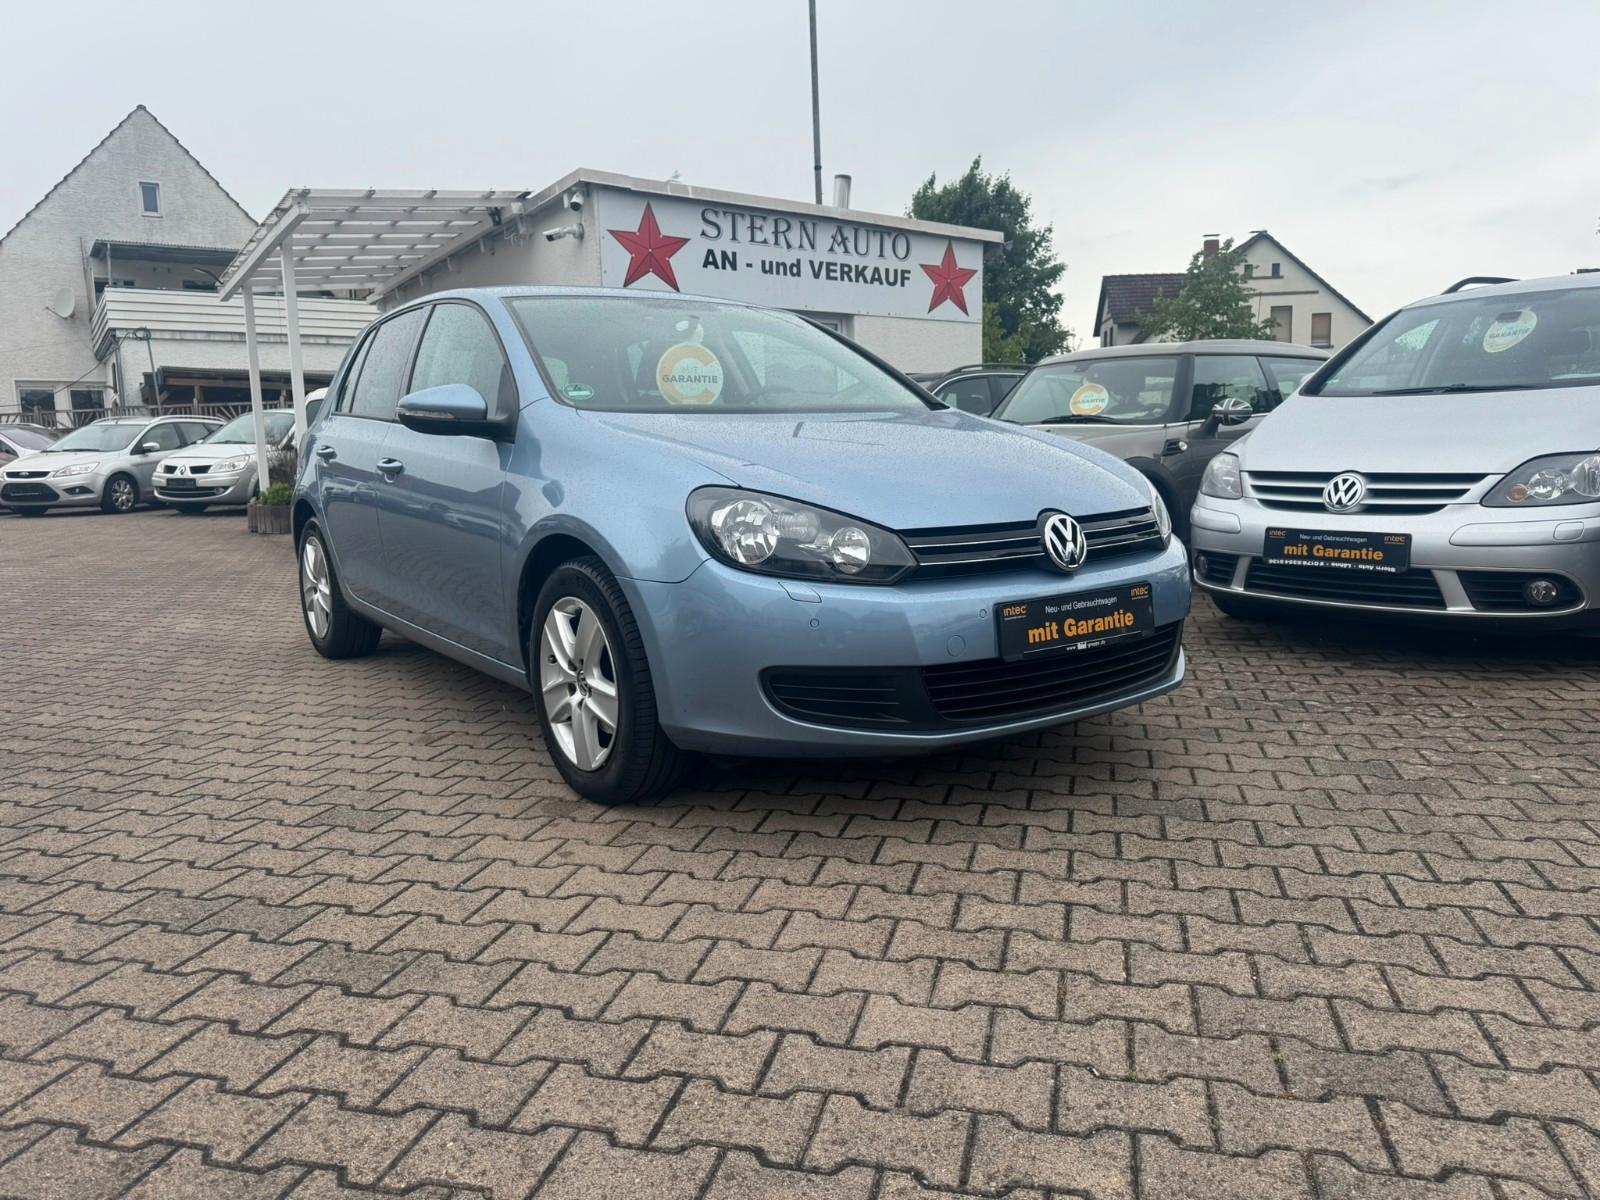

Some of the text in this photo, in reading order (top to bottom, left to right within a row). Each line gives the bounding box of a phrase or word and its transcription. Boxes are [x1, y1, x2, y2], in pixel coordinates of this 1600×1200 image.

[700, 207, 912, 261] STERN AUTO
[702, 248, 738, 271] AN
[761, 258, 801, 278] und
[808, 260, 912, 288] VERKAUF
[662, 374, 718, 384] GARANTIE
[1283, 543, 1384, 561] mit Garantie
[1130, 585, 1149, 597] intec
[1003, 604, 1028, 617] intec
[1045, 604, 1060, 614] Neu-
[1060, 601, 1072, 612] und
[1073, 596, 1118, 610] Gebrauchtwagen
[1027, 609, 1135, 644] mit Garantie
